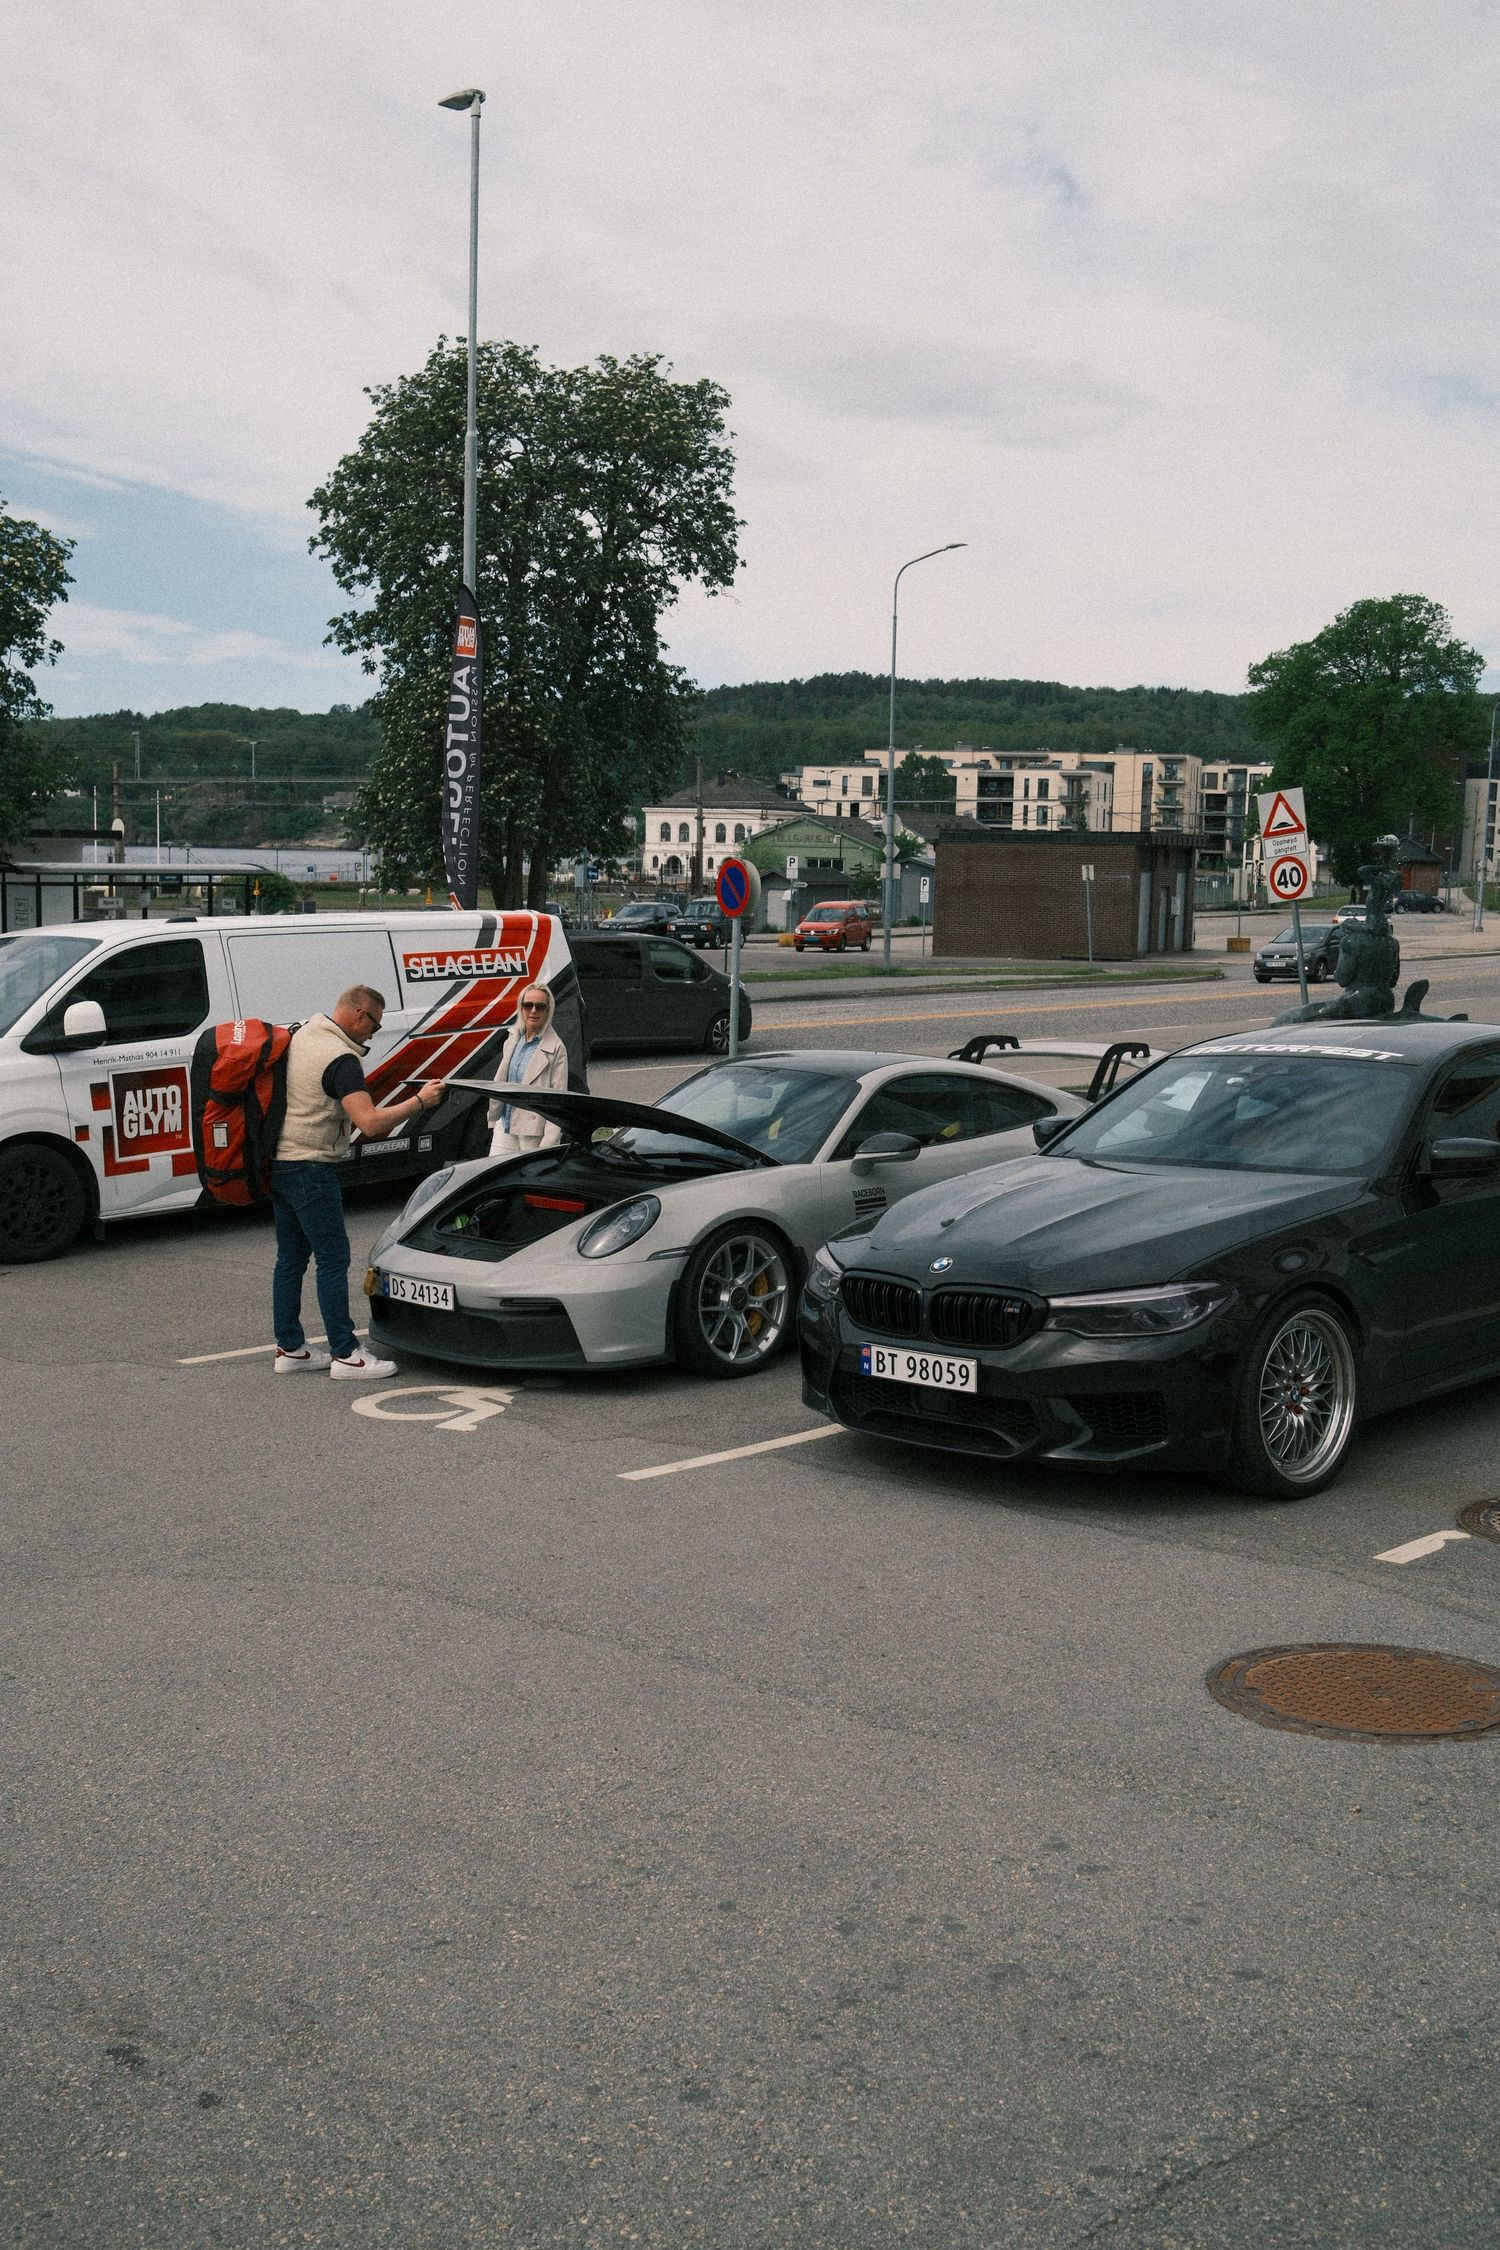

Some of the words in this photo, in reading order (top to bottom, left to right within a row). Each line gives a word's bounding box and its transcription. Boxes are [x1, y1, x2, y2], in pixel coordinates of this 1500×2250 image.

[1272, 837, 1298, 847] Opphøyd
[1274, 845, 1297, 855] gangfelt
[790, 857, 796, 867] P
[922, 878, 928, 890] P
[1277, 866, 1302, 889] 40
[408, 952, 522, 979] SELACLEAN
[93, 1054, 144, 1066] Henrik-Mathias
[145, 1050, 158, 1059] 904
[160, 1049, 168, 1058] 14
[169, 1048, 181, 1057] 911
[1183, 1044, 1404, 1060] MOTORFEST
[123, 1085, 182, 1115] AUTO
[123, 1108, 182, 1139] GLYM
[363, 1141, 408, 1155] SELACLEAN
[852, 1186, 886, 1199] RACEBORN
[392, 1278, 406, 1298] DS
[410, 1282, 449, 1306] 24134
[863, 1362, 870, 1370] N
[876, 1350, 898, 1375] BT
[906, 1356, 970, 1387] 98059
